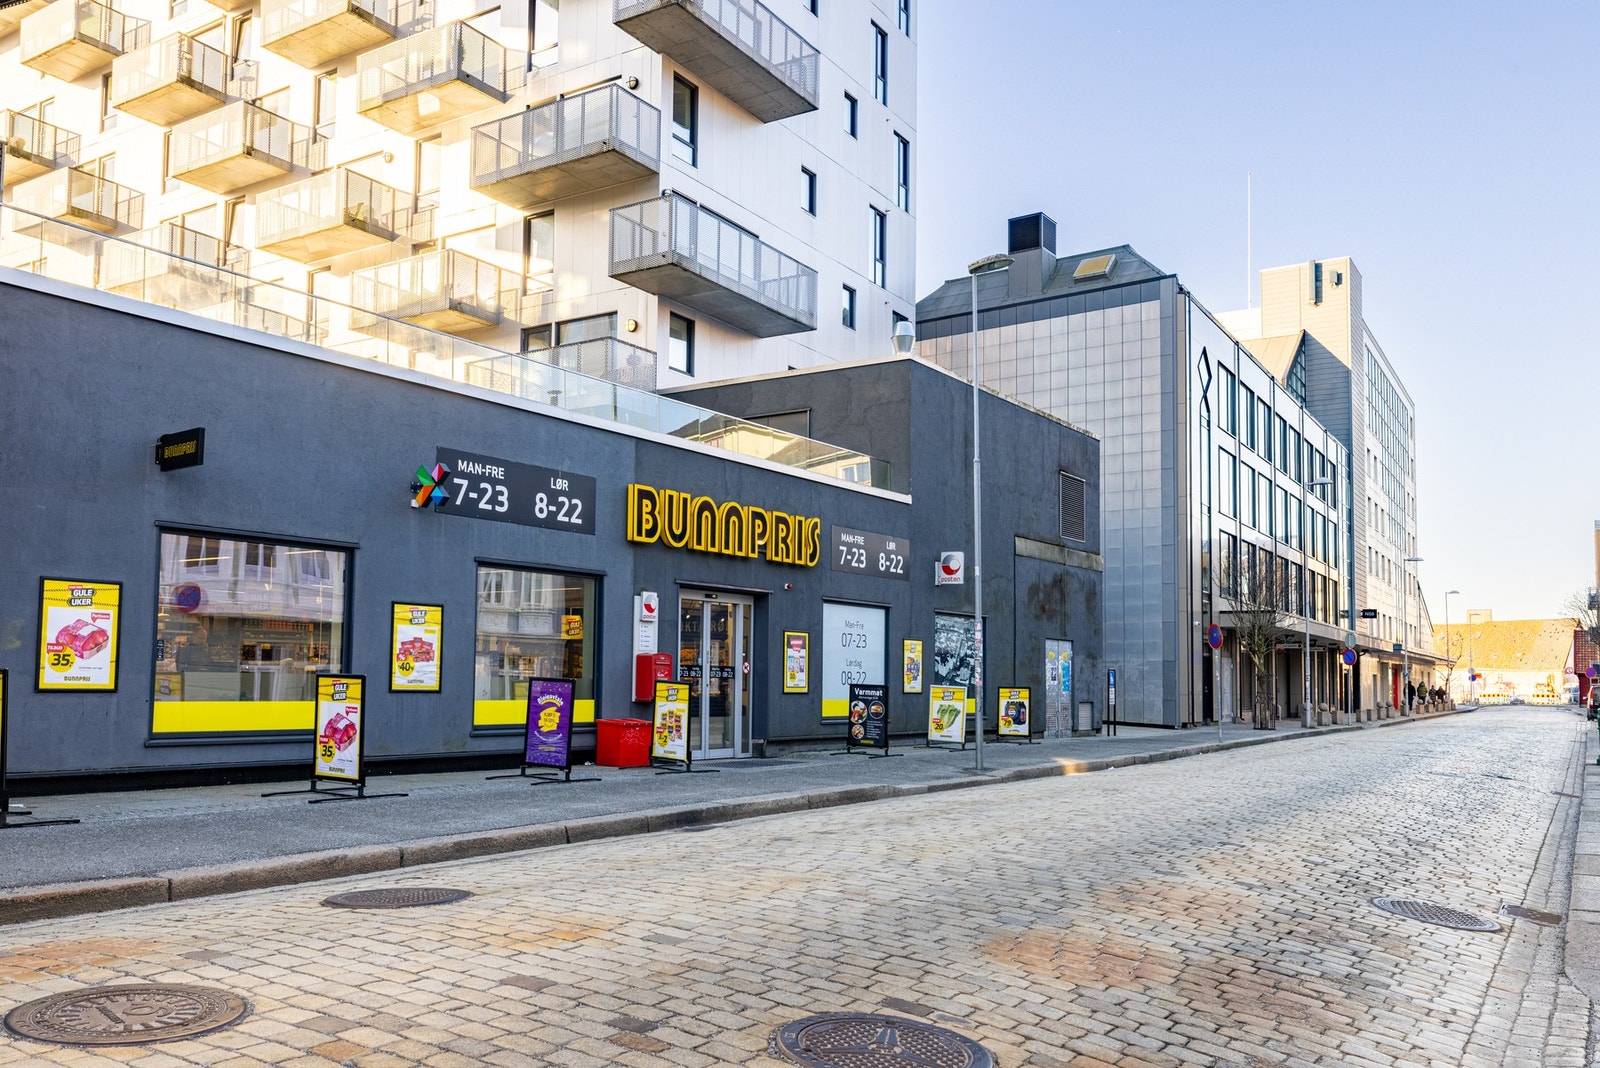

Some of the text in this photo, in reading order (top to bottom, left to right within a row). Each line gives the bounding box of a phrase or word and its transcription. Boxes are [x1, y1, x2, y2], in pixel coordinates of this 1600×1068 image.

[163, 440, 197, 459] BUNNPRIS
[457, 459, 505, 480] MAN-FRE
[550, 477, 569, 492] LØR
[453, 477, 509, 512] 7-23
[534, 492, 583, 524] 8-22
[626, 482, 821, 568] BUNNPRIS
[841, 532, 865, 546] MAN-FRE
[839, 545, 867, 569] 7-23
[878, 552, 904, 574] 8-22
[73, 589, 93, 597] GULE
[71, 598, 92, 606] UKER
[844, 620, 865, 630] Man-Fre
[841, 632, 868, 649] 07-23
[845, 659, 863, 670] Lørdag
[840, 670, 867, 686] 08-22
[334, 683, 348, 691] GULE
[854, 688, 884, 697] Varmmat
[333, 692, 347, 700] UKER
